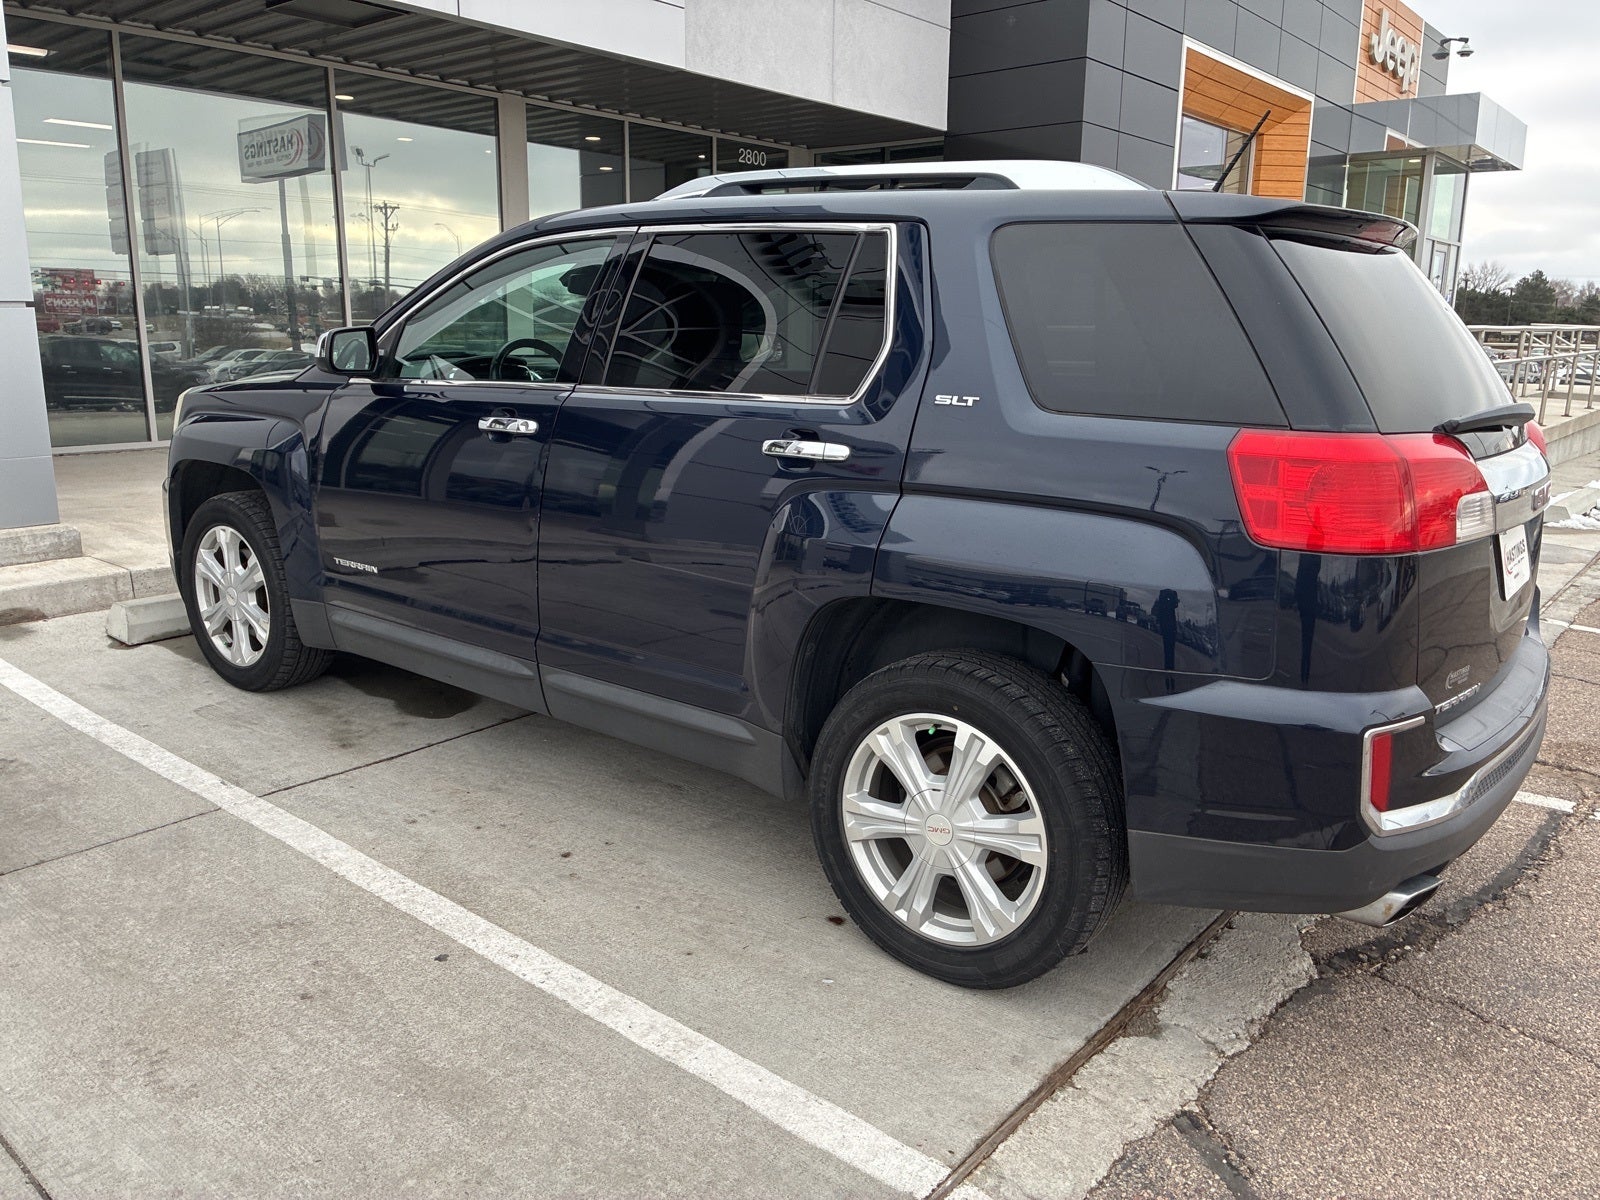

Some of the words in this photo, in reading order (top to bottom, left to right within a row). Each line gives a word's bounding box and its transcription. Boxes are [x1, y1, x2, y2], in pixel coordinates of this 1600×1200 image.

[1370, 8, 1417, 93] Jeep
[738, 148, 767, 167] 2800
[934, 394, 980, 407] SLT
[332, 556, 378, 574] TERRAIN
[1434, 682, 1481, 715] TERRAIN
[926, 825, 951, 835] GMC
